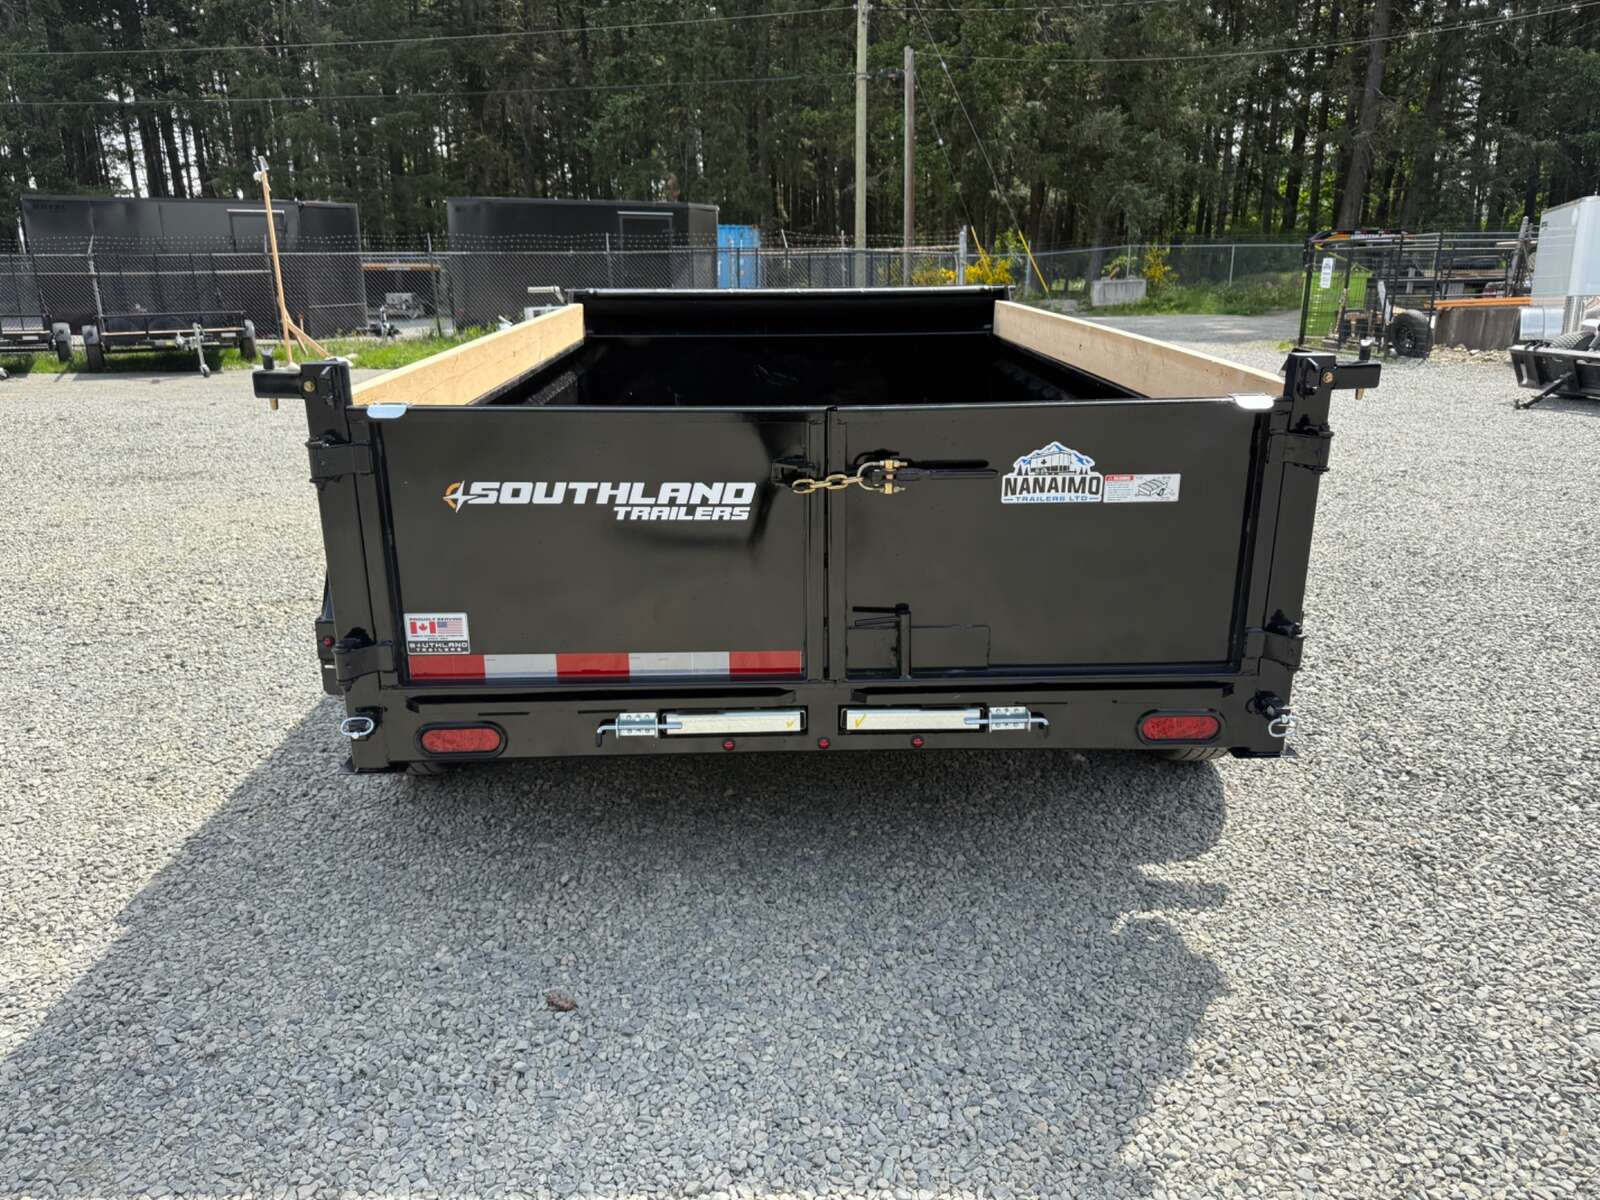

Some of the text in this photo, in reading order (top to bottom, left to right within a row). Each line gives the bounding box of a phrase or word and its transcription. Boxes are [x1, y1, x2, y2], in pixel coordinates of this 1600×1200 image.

[468, 481, 757, 505] SOUTHLAND
[1004, 475, 1103, 497] NANAIMO
[613, 506, 750, 521] TRAILERS
